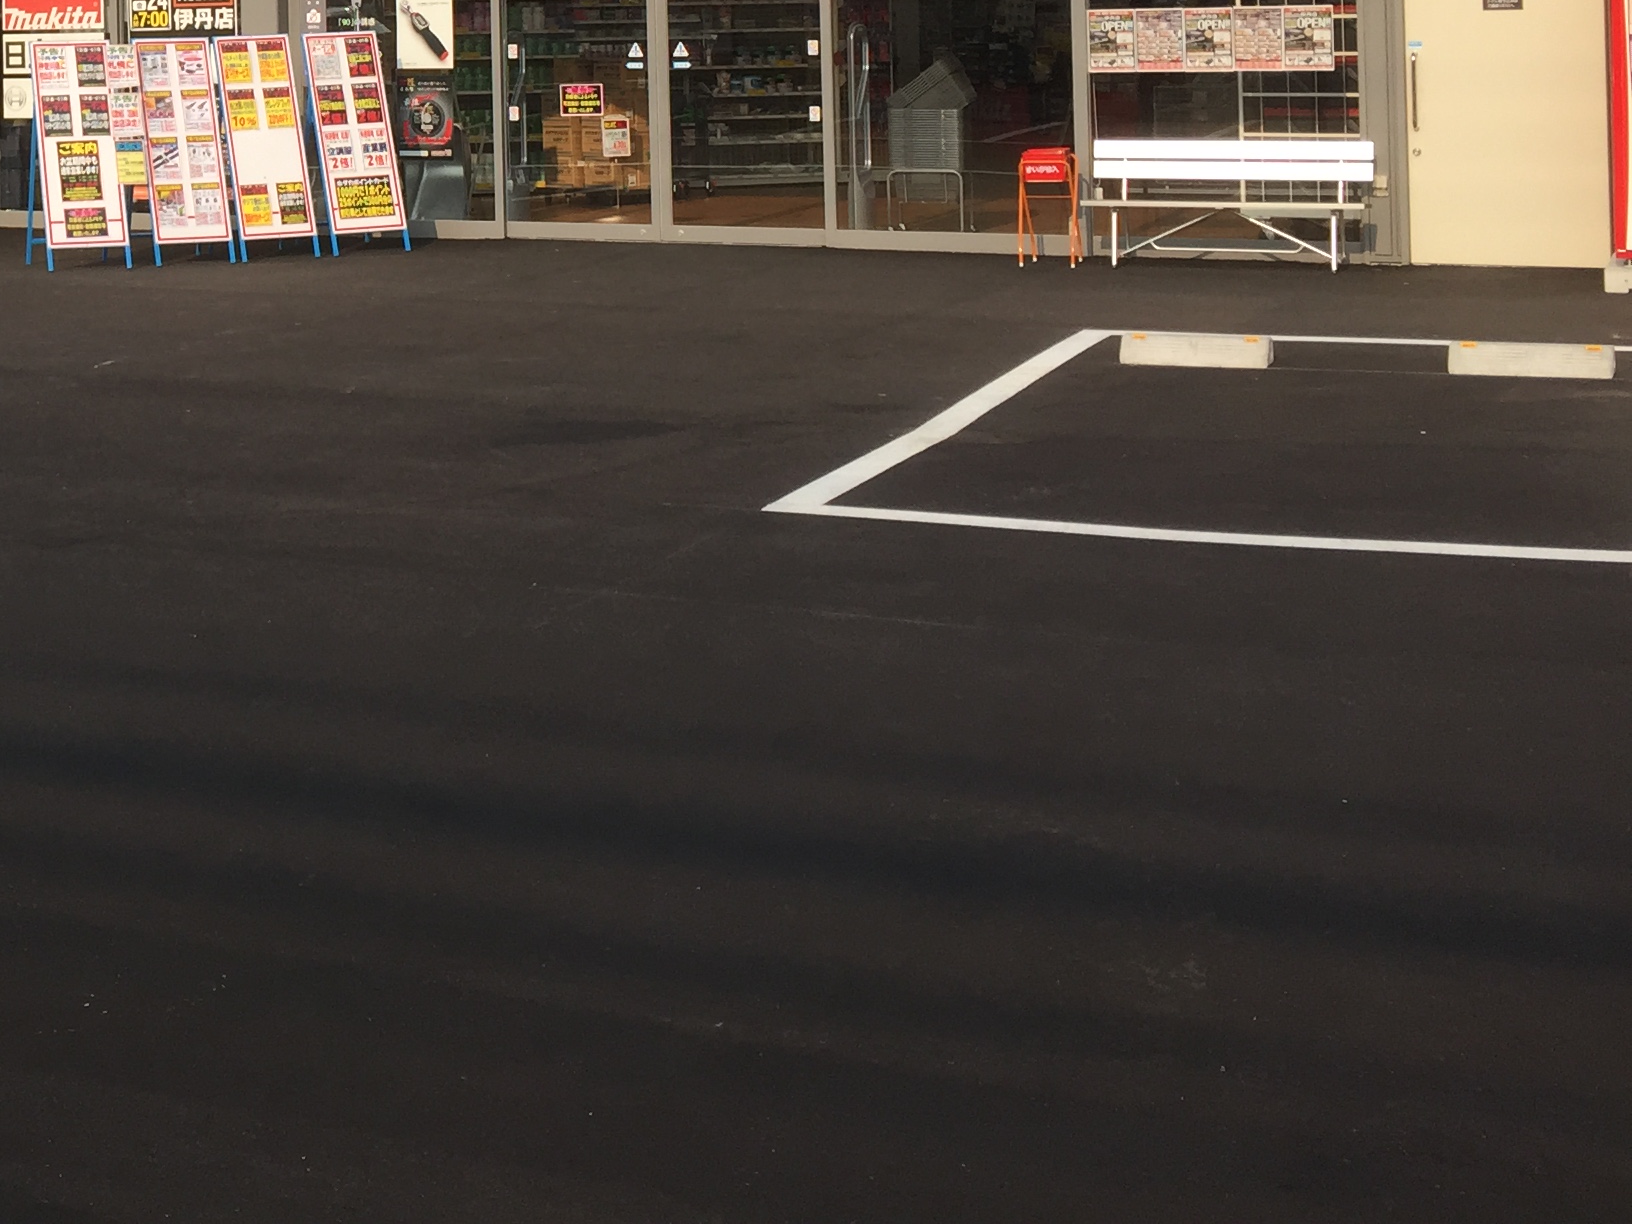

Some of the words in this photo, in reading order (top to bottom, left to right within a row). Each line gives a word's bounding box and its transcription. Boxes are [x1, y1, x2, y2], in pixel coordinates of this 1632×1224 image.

[5, 5, 99, 30] makita
[173, 7, 234, 31] 伊丹店
